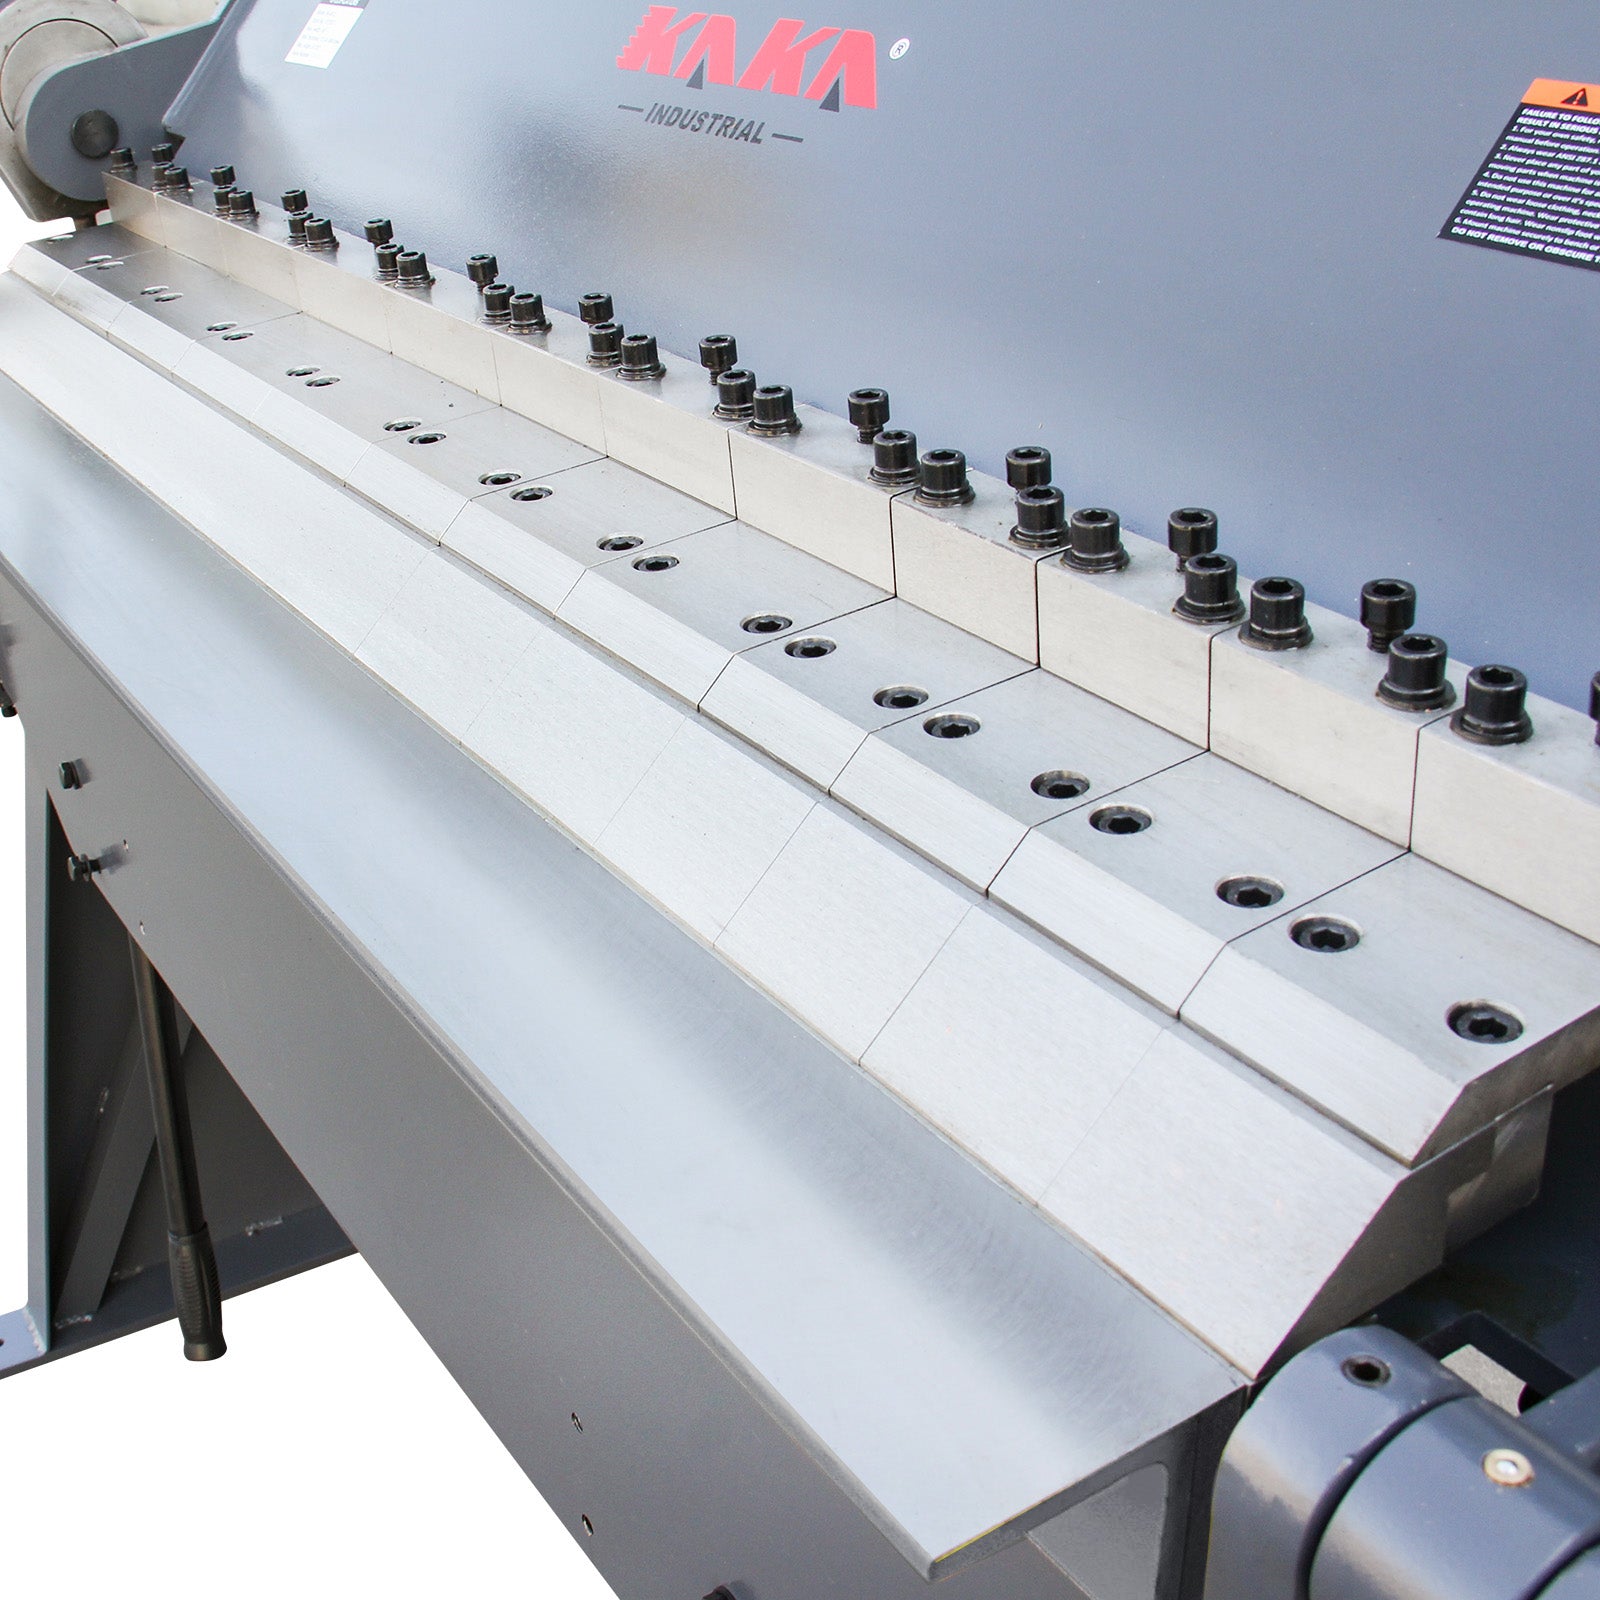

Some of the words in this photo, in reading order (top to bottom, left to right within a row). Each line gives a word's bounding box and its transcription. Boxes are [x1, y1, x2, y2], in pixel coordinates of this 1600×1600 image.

[616, 5, 878, 112] KAKA
[644, 102, 766, 145] INDUSTRIAL
[1516, 116, 1549, 127] RESULT
[1549, 121, 1561, 129] IN
[1560, 123, 1599, 135] SERIOUS
[1521, 107, 1558, 119] FAILURE
[1558, 112, 1572, 121] TO
[1450, 226, 1467, 236] DO
[1466, 228, 1488, 240] NOT
[1486, 233, 1530, 248] REMOVE
[1527, 241, 1545, 251] OR
[1544, 245, 1595, 262] OBSCURE
